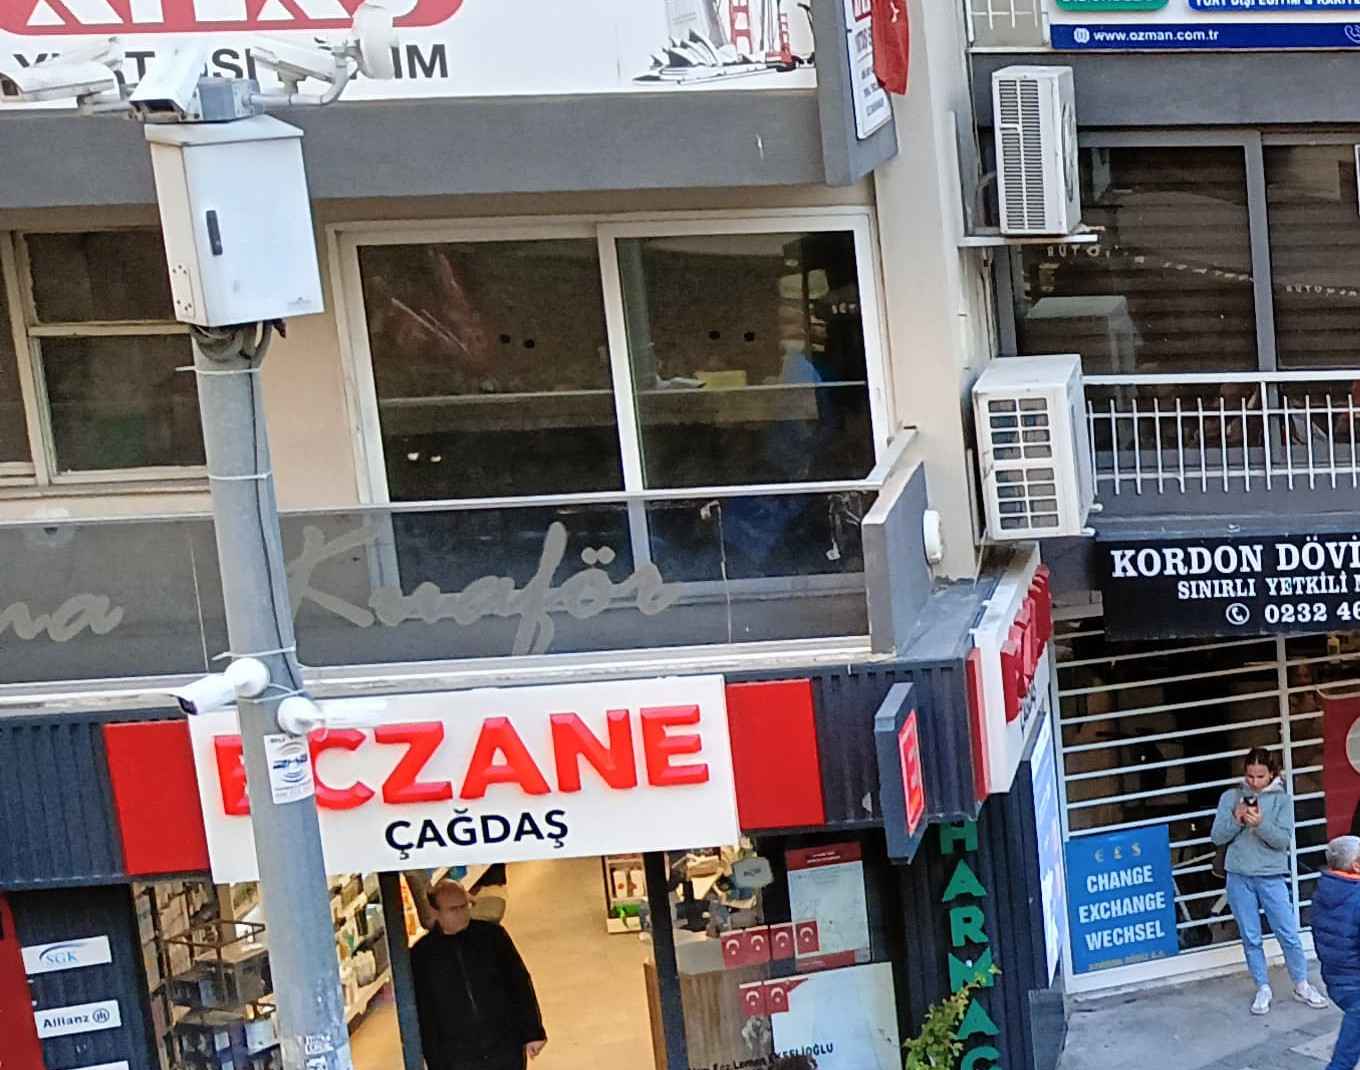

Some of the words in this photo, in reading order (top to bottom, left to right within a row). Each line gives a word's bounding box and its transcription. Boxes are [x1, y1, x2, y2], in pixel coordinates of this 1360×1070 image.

[1093, 30, 1219, 42] www.ozman.com.tr
[1111, 544, 1264, 579] KORDON
[1178, 575, 1257, 600] SINIRLI
[1265, 569, 1347, 597] YETKİLİ
[1264, 602, 1328, 625] 0232
[384, 808, 569, 861] ÇAĞDAŞ
[1086, 865, 1154, 894] CHANGE
[1078, 891, 1166, 924] EXCHANGE
[1085, 920, 1166, 951] WECHSEL
[43, 1014, 90, 1028] Allianz
